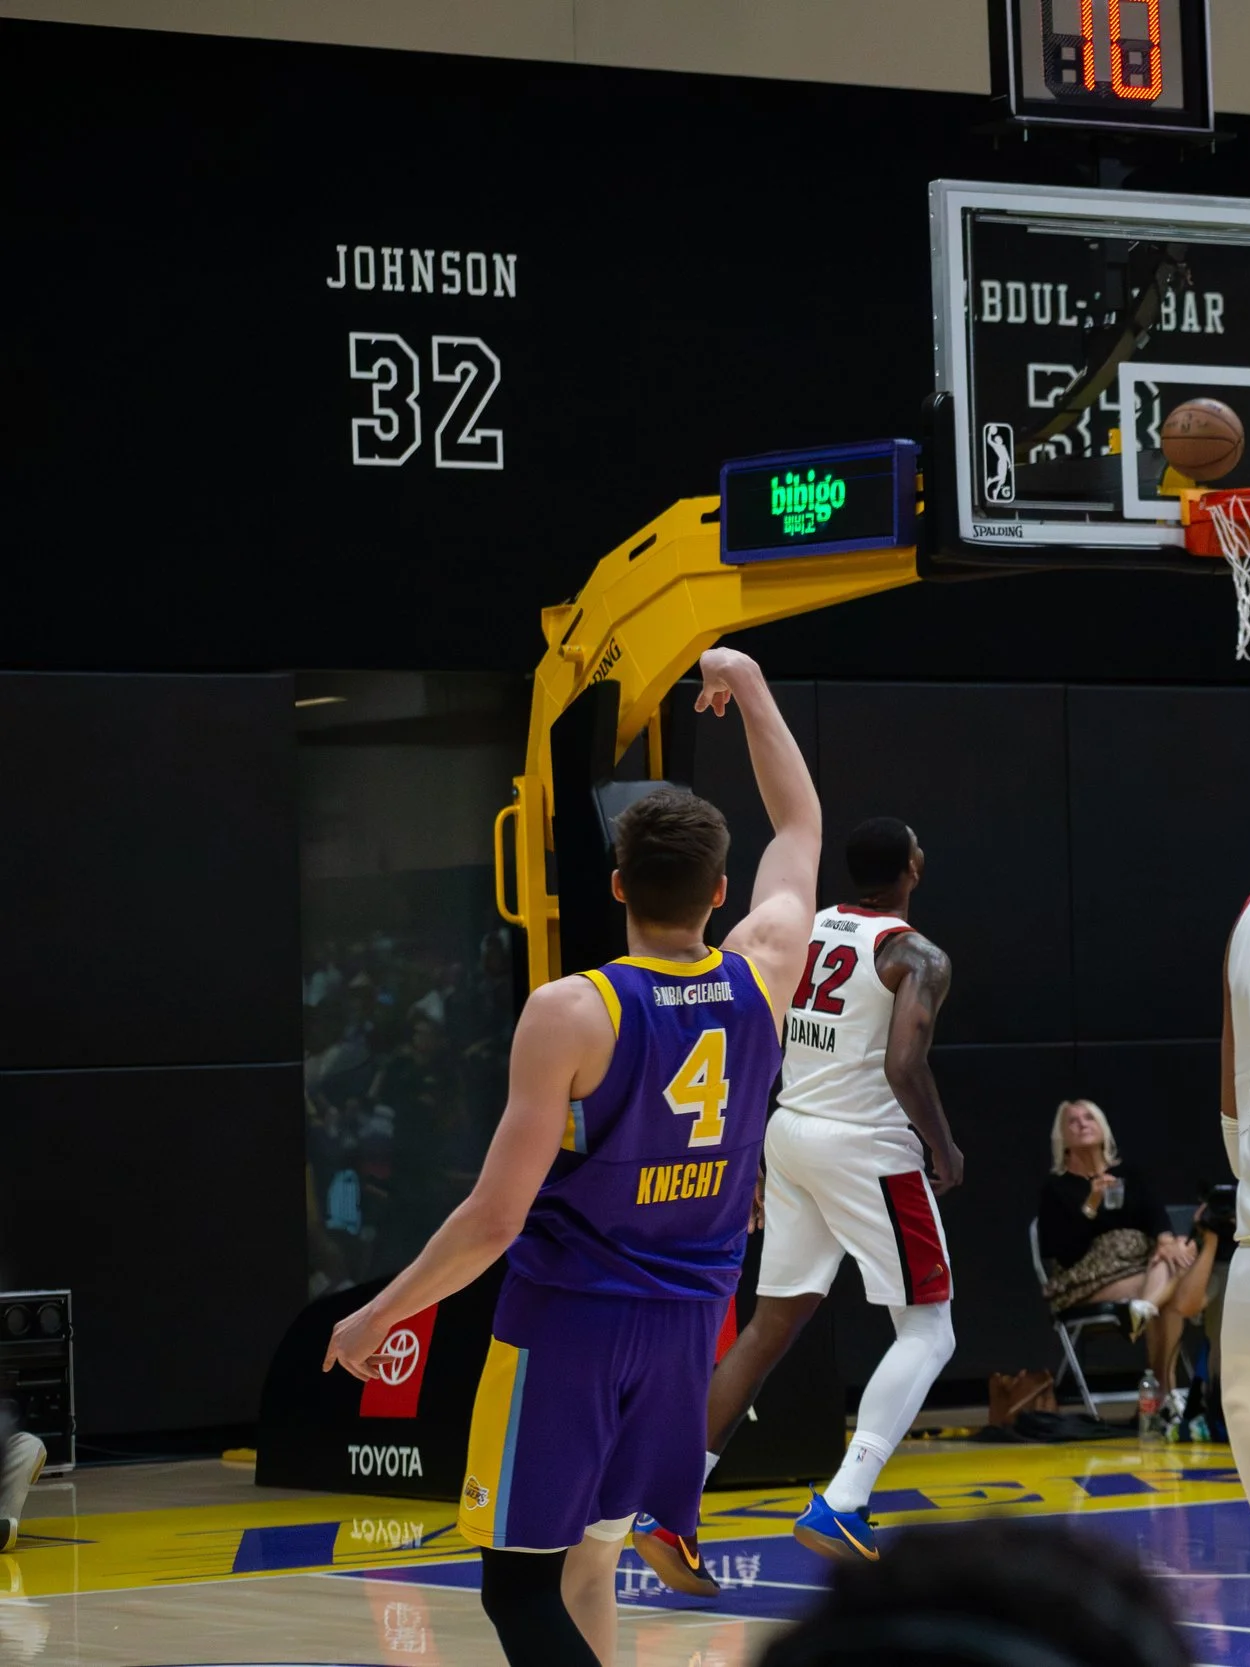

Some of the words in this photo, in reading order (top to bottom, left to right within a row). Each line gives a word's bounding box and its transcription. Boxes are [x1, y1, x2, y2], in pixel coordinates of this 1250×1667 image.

[326, 244, 517, 298] JOHNSON
[349, 331, 504, 470] 32
[770, 469, 846, 522] bibigo
[973, 525, 1023, 538] SPALDING
[791, 1017, 836, 1053] DAINJA
[663, 1028, 730, 1148] 4
[636, 1160, 728, 1205] KNECHT
[348, 1444, 423, 1477] TOYOTA
